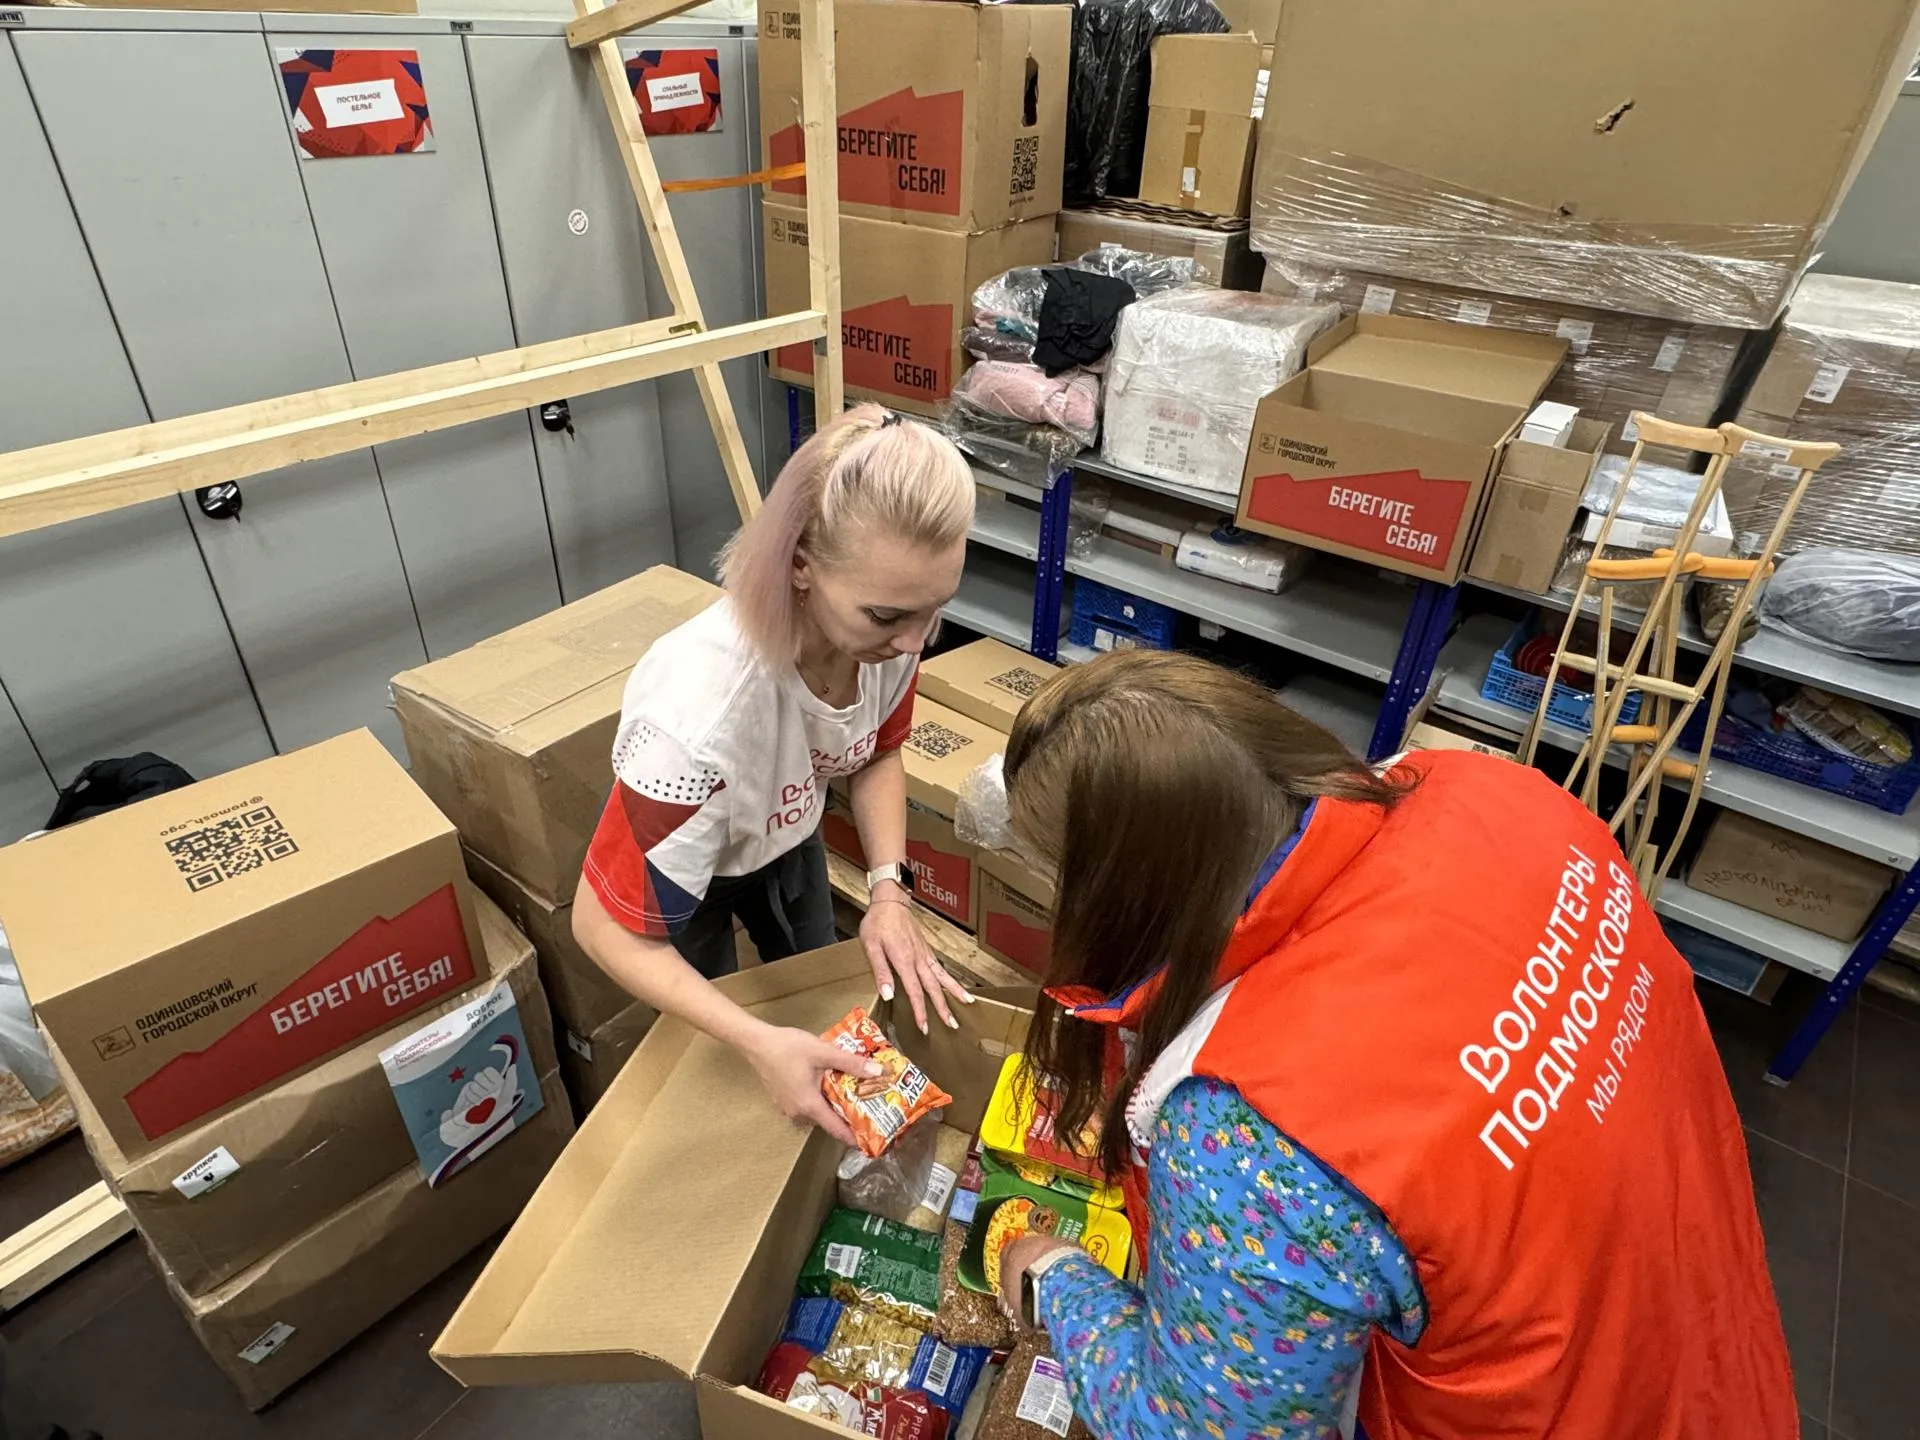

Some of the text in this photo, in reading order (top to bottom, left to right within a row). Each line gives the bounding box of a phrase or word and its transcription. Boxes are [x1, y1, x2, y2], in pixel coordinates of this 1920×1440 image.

[336, 91, 382, 105] ПОСТЕЛЬНОЕ
[838, 127, 917, 161] БЕРЕГИТЕ
[898, 164, 946, 196] СЕБЯ!
[894, 361, 937, 391] СЕБЯ!
[1315, 457, 1337, 469] ОКРУГ
[1328, 485, 1415, 525] БЕРЕГИТЕ
[1385, 524, 1438, 556] СЕБЯ!
[159, 795, 264, 837] @pomosh_ogo
[920, 878, 958, 908] СЕБЯ!
[270, 951, 408, 1035] БЕРЕГИТЕ
[382, 955, 454, 1007] СЕБЯ!
[135, 977, 234, 1031] ОДИНЦОВСКИЙ
[142, 982, 259, 1044] ГОРОДСКОЙ ОКРУГ
[466, 992, 503, 1021] ДОБРОЕ
[470, 1009, 495, 1031] ДЕЛО
[1586, 961, 1656, 1124] МЫ РЯДОМ
